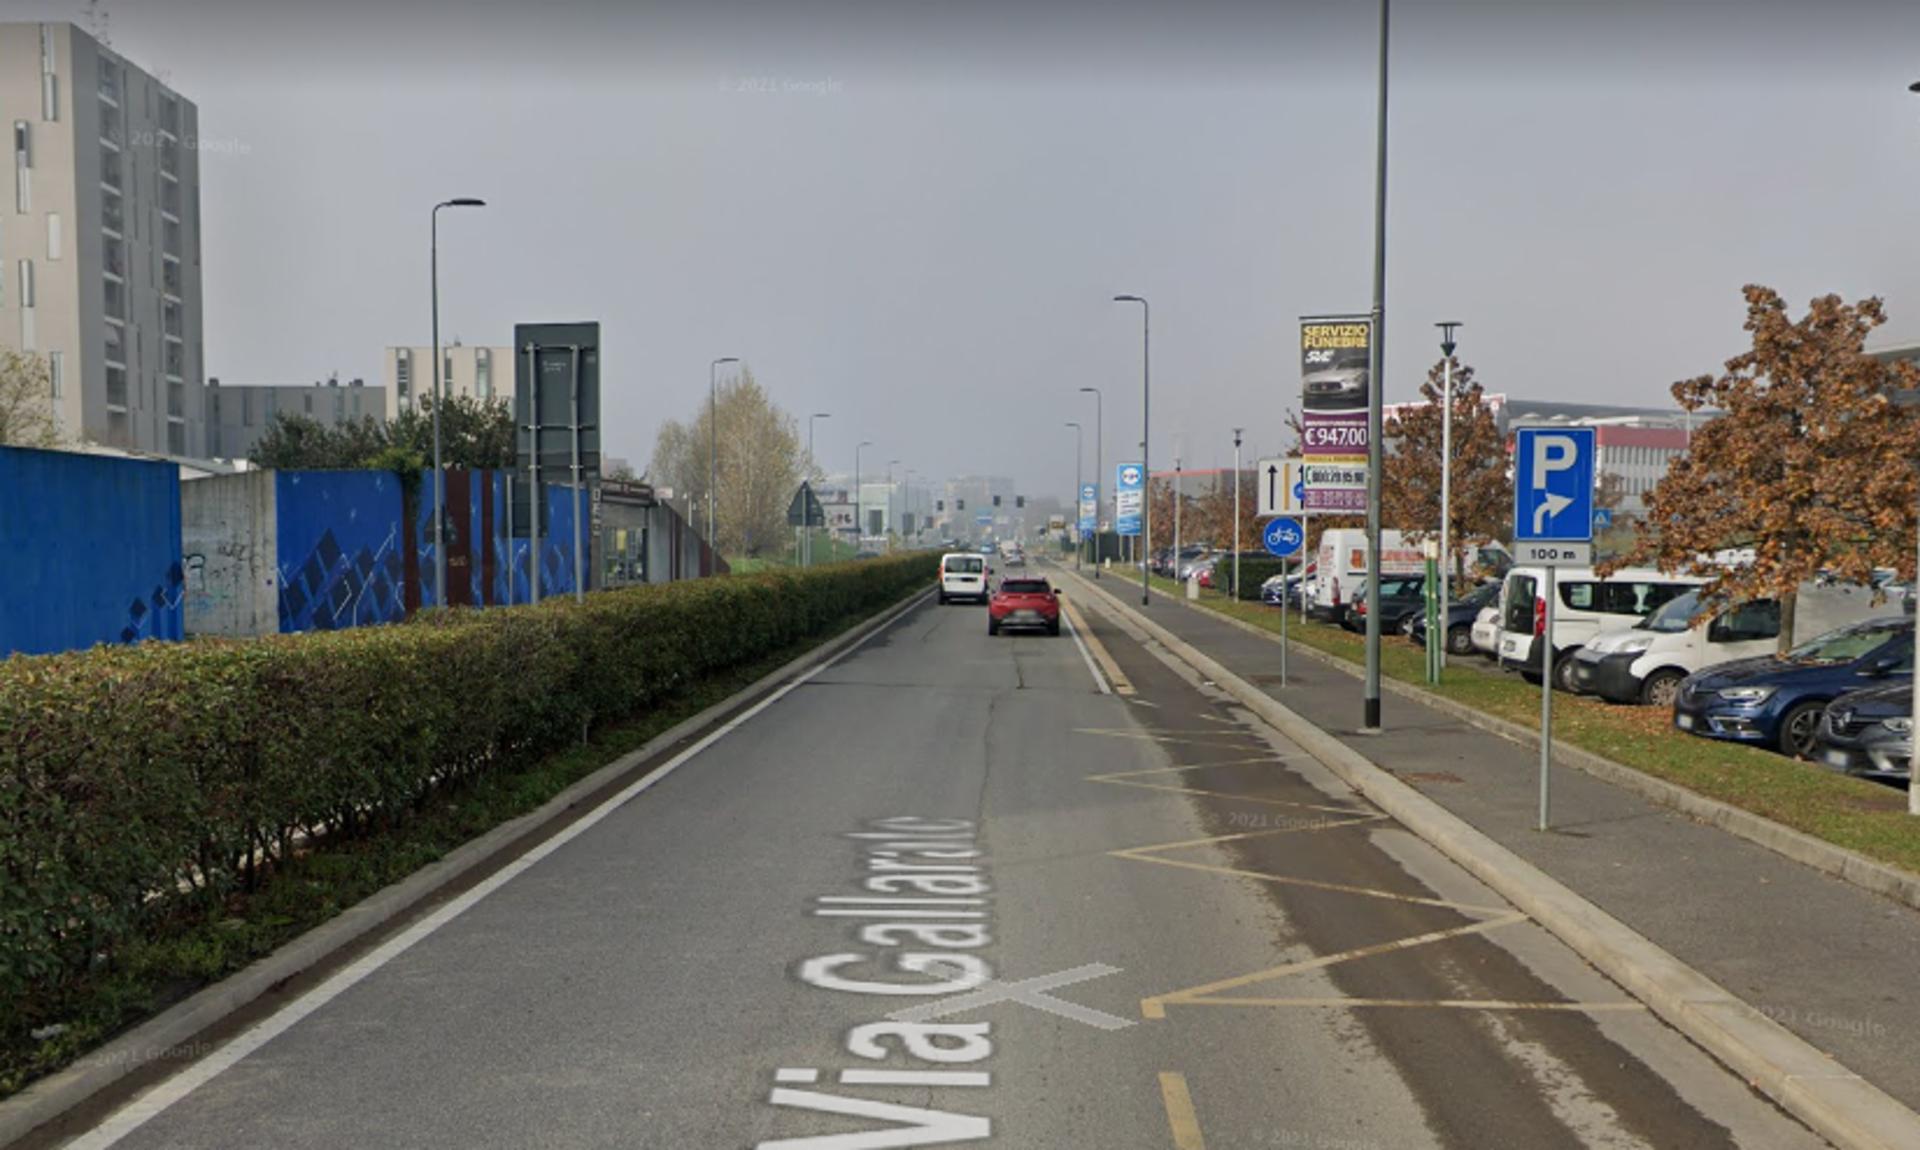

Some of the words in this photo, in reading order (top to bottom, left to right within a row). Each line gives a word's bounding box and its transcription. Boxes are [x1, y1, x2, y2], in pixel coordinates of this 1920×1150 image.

[1304, 324, 1368, 337] SERVIZIO
[1533, 434, 1577, 490] P
[1530, 549, 1558, 560] 100
[1563, 550, 1576, 560] m
